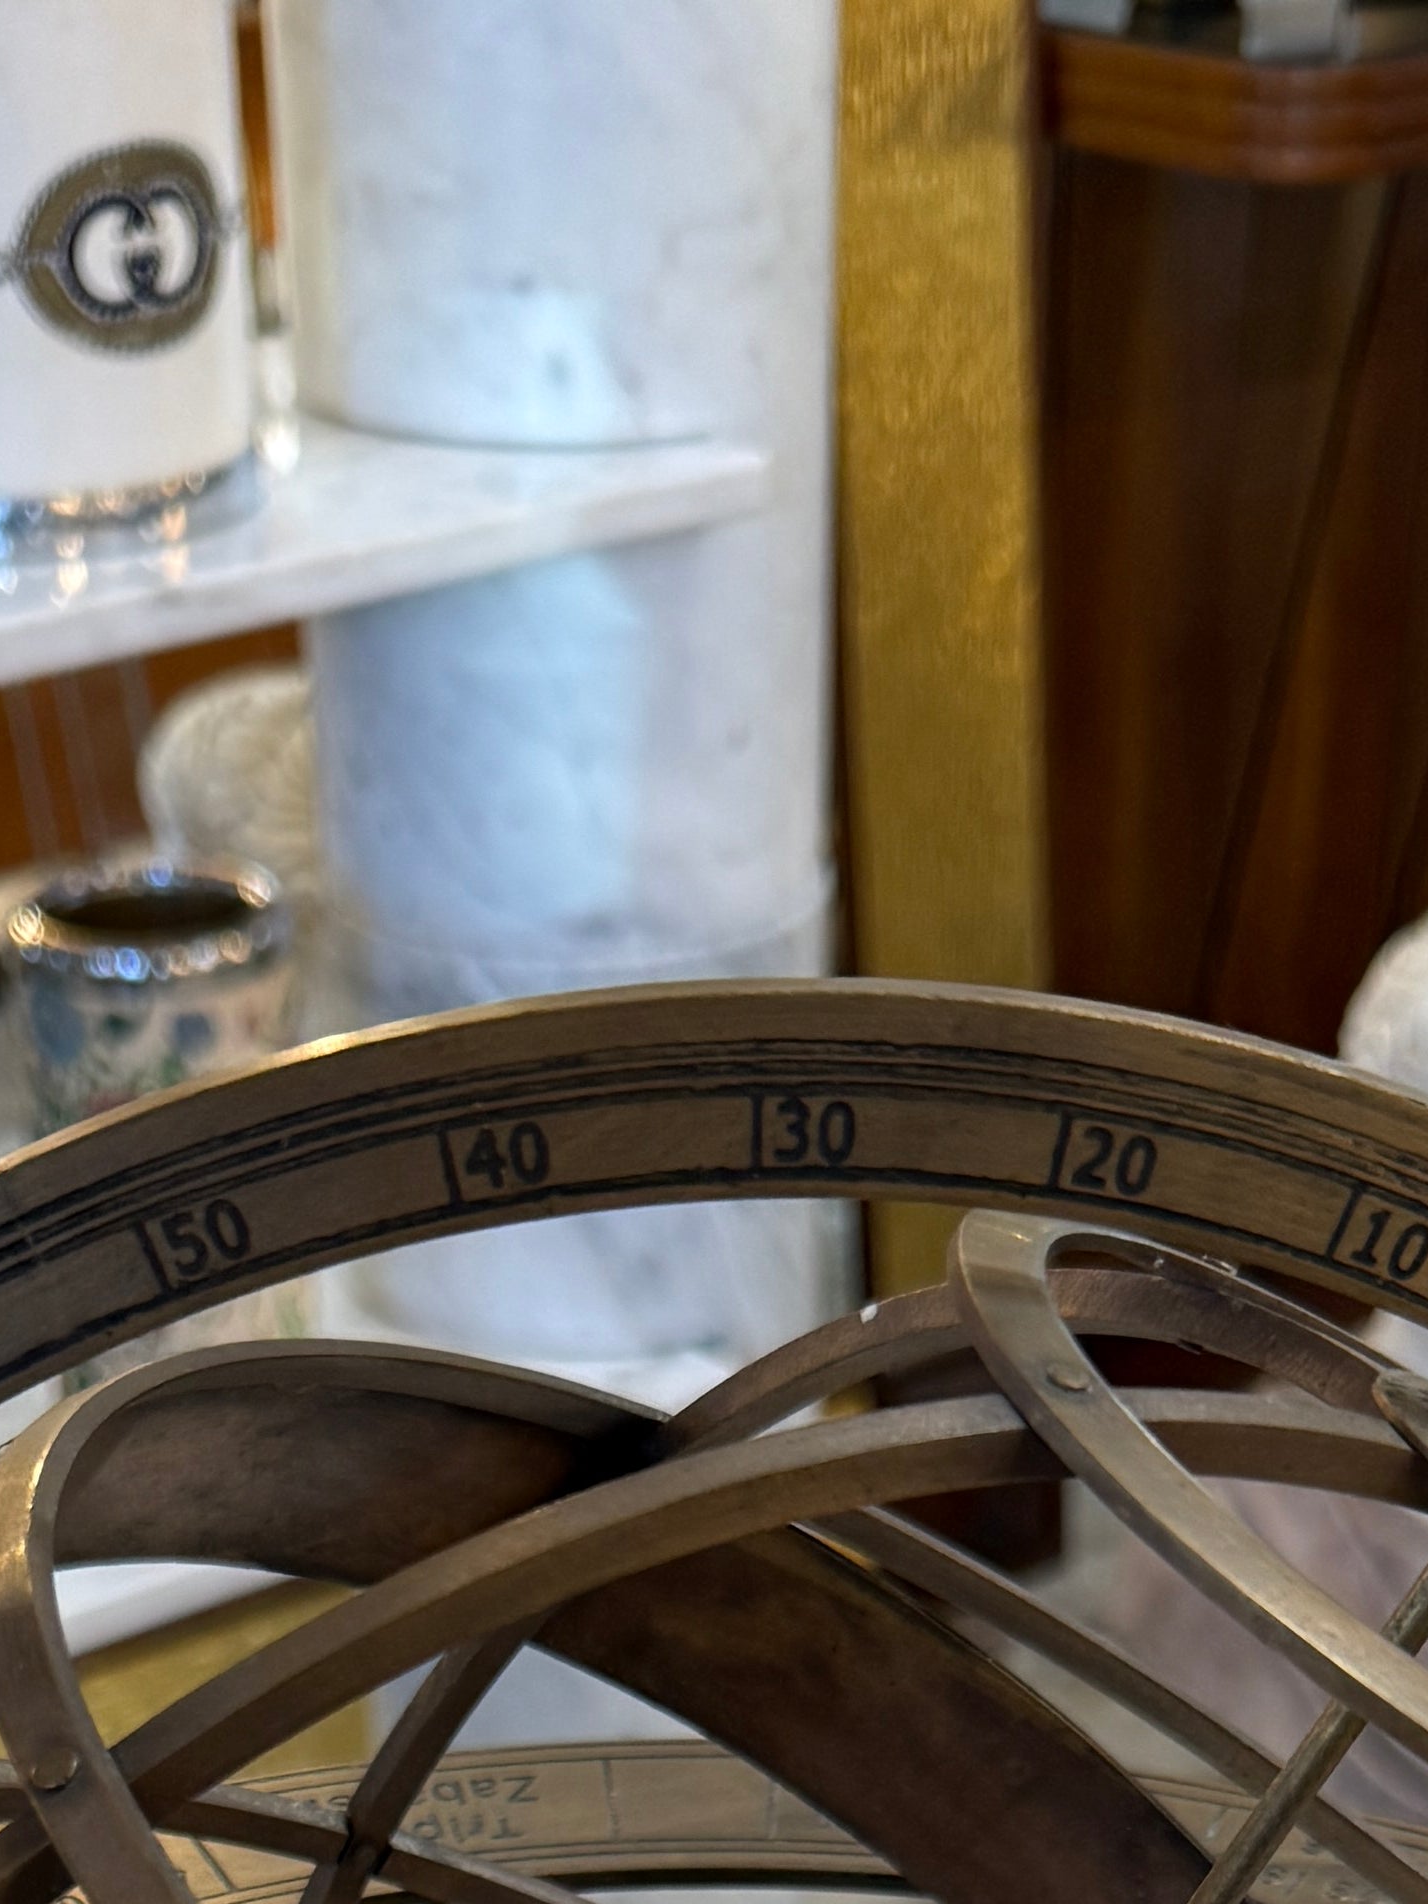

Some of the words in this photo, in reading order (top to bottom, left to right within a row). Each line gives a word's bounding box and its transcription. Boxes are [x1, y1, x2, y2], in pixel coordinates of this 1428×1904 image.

[463, 1120, 550, 1190] 40
[774, 1094, 857, 1168] 30
[1070, 1124, 1158, 1197] 20
[169, 1199, 252, 1278] 50
